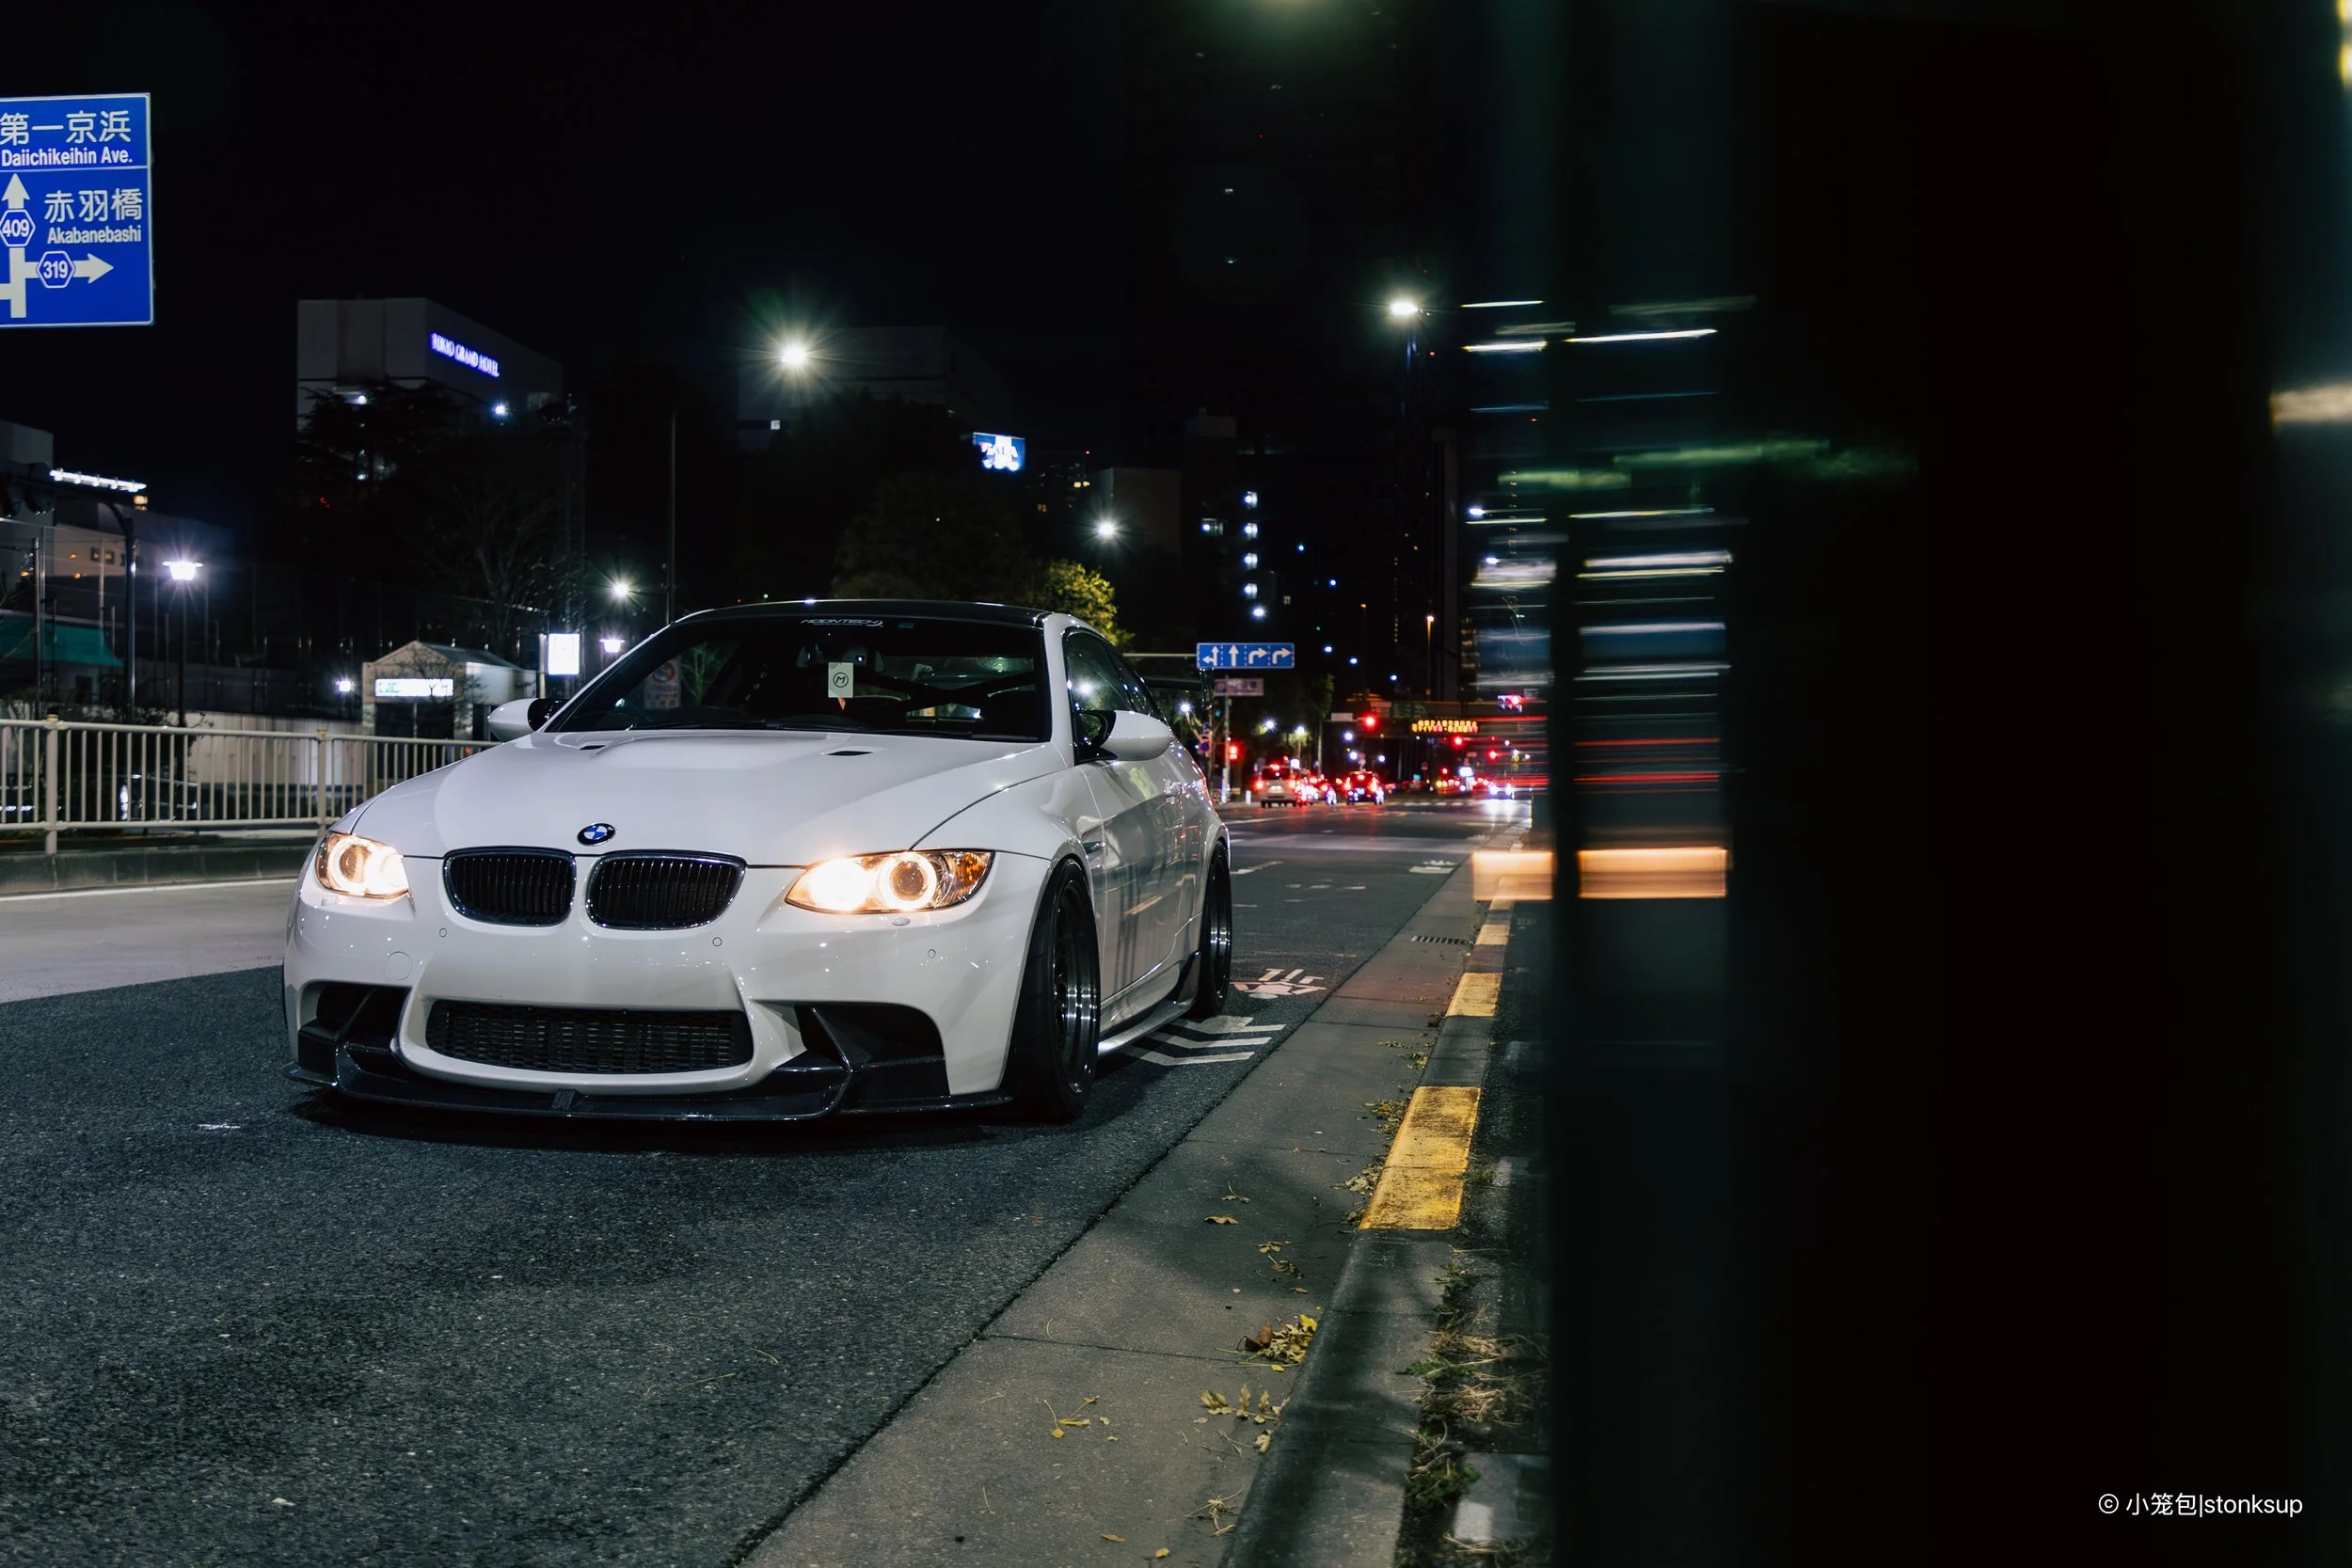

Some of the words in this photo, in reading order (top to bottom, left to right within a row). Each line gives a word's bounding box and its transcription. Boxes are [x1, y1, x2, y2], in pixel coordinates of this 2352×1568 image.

[0, 110, 132, 146] 第一京浜
[2, 147, 97, 166] Daiichikeihin
[101, 147, 133, 164] Ave.
[44, 188, 143, 223] 赤羽橋
[2, 218, 29, 238] 409
[47, 225, 142, 245] Akabanebashi
[42, 261, 69, 279] 319
[454, 344, 479, 368] GRAND
[478, 354, 500, 378] HOTEL
